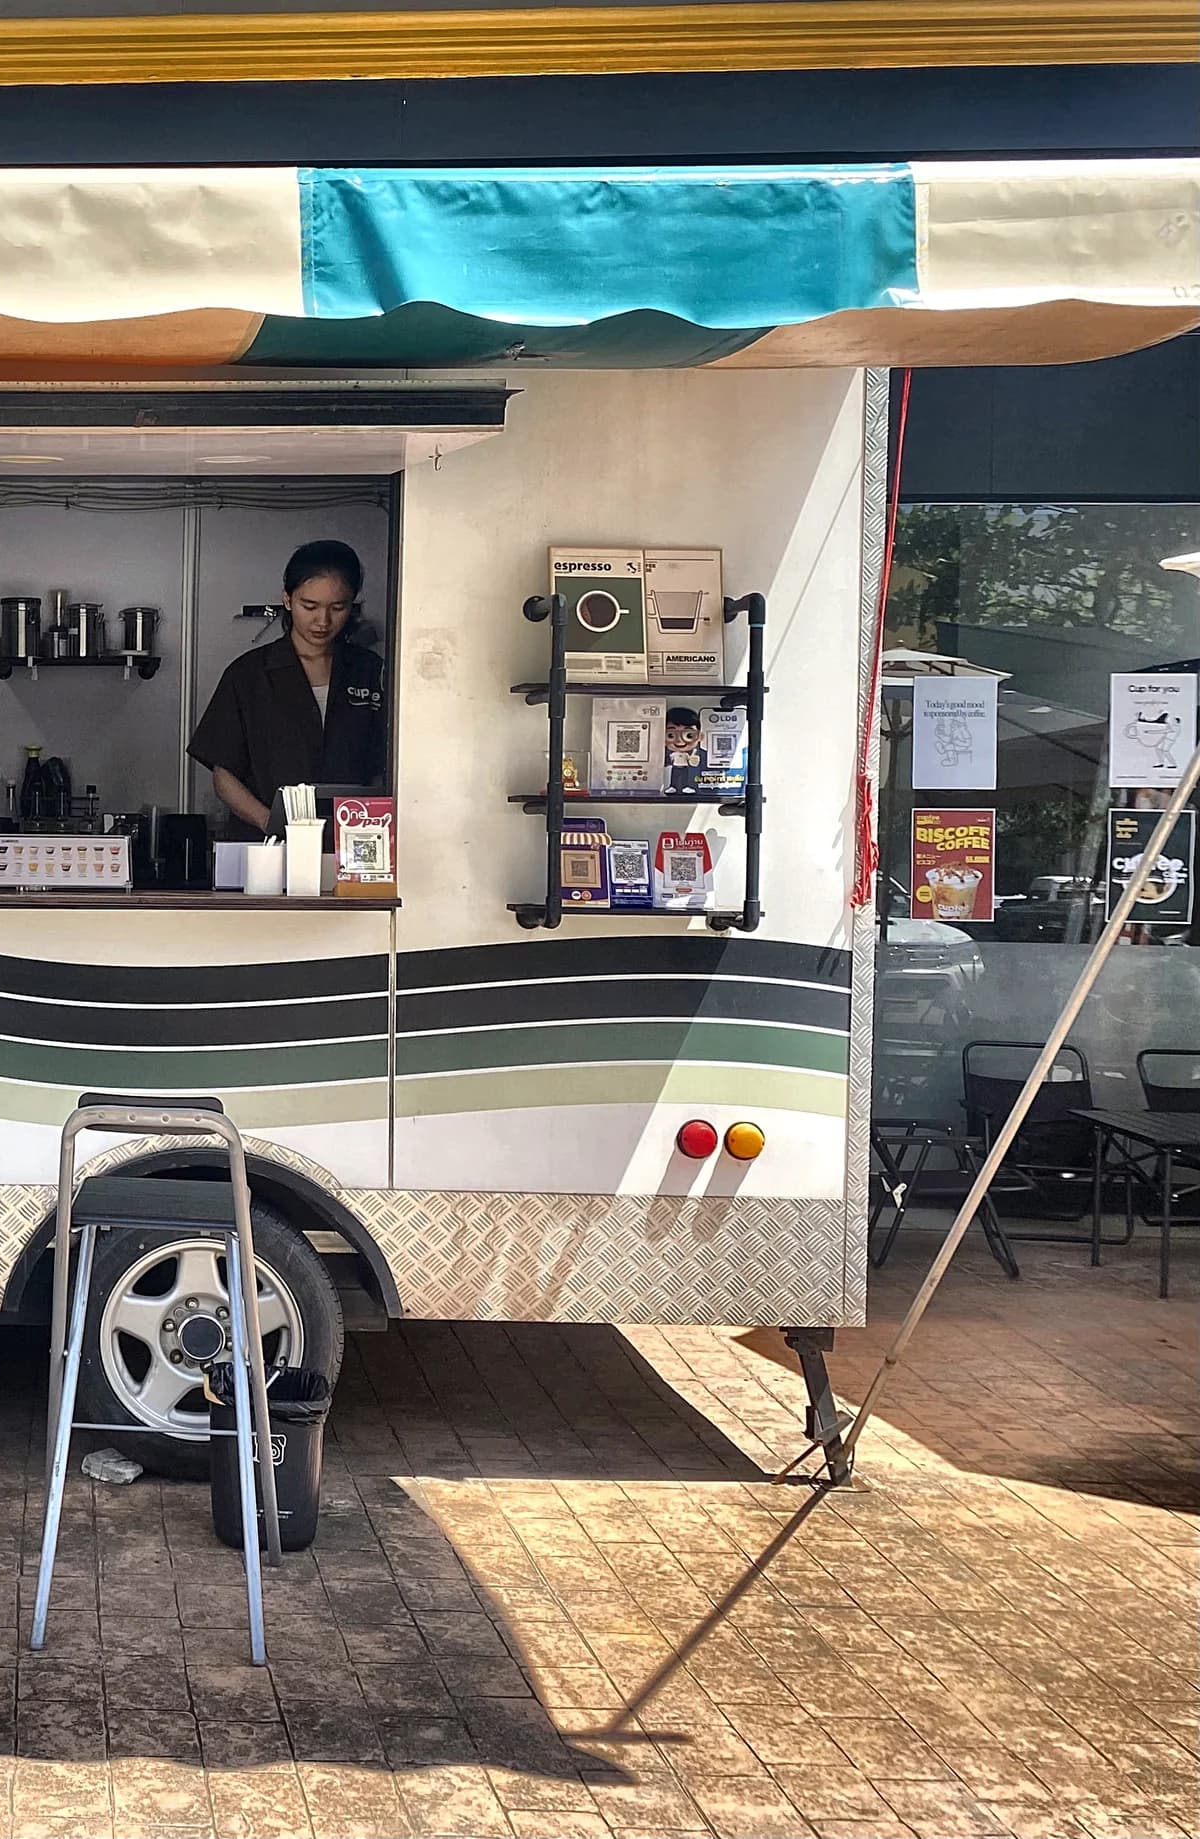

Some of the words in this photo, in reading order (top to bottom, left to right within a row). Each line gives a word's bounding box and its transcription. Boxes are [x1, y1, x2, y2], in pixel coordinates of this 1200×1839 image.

[554, 561, 612, 573] espresso
[665, 655, 716, 663] AMERICANO
[1128, 684, 1147, 694] Cup
[1148, 684, 1160, 693] for
[1160, 686, 1180, 694] you
[720, 714, 738, 722] LDB
[916, 826, 991, 844] BISCOFF
[936, 836, 990, 851] COFFEE
